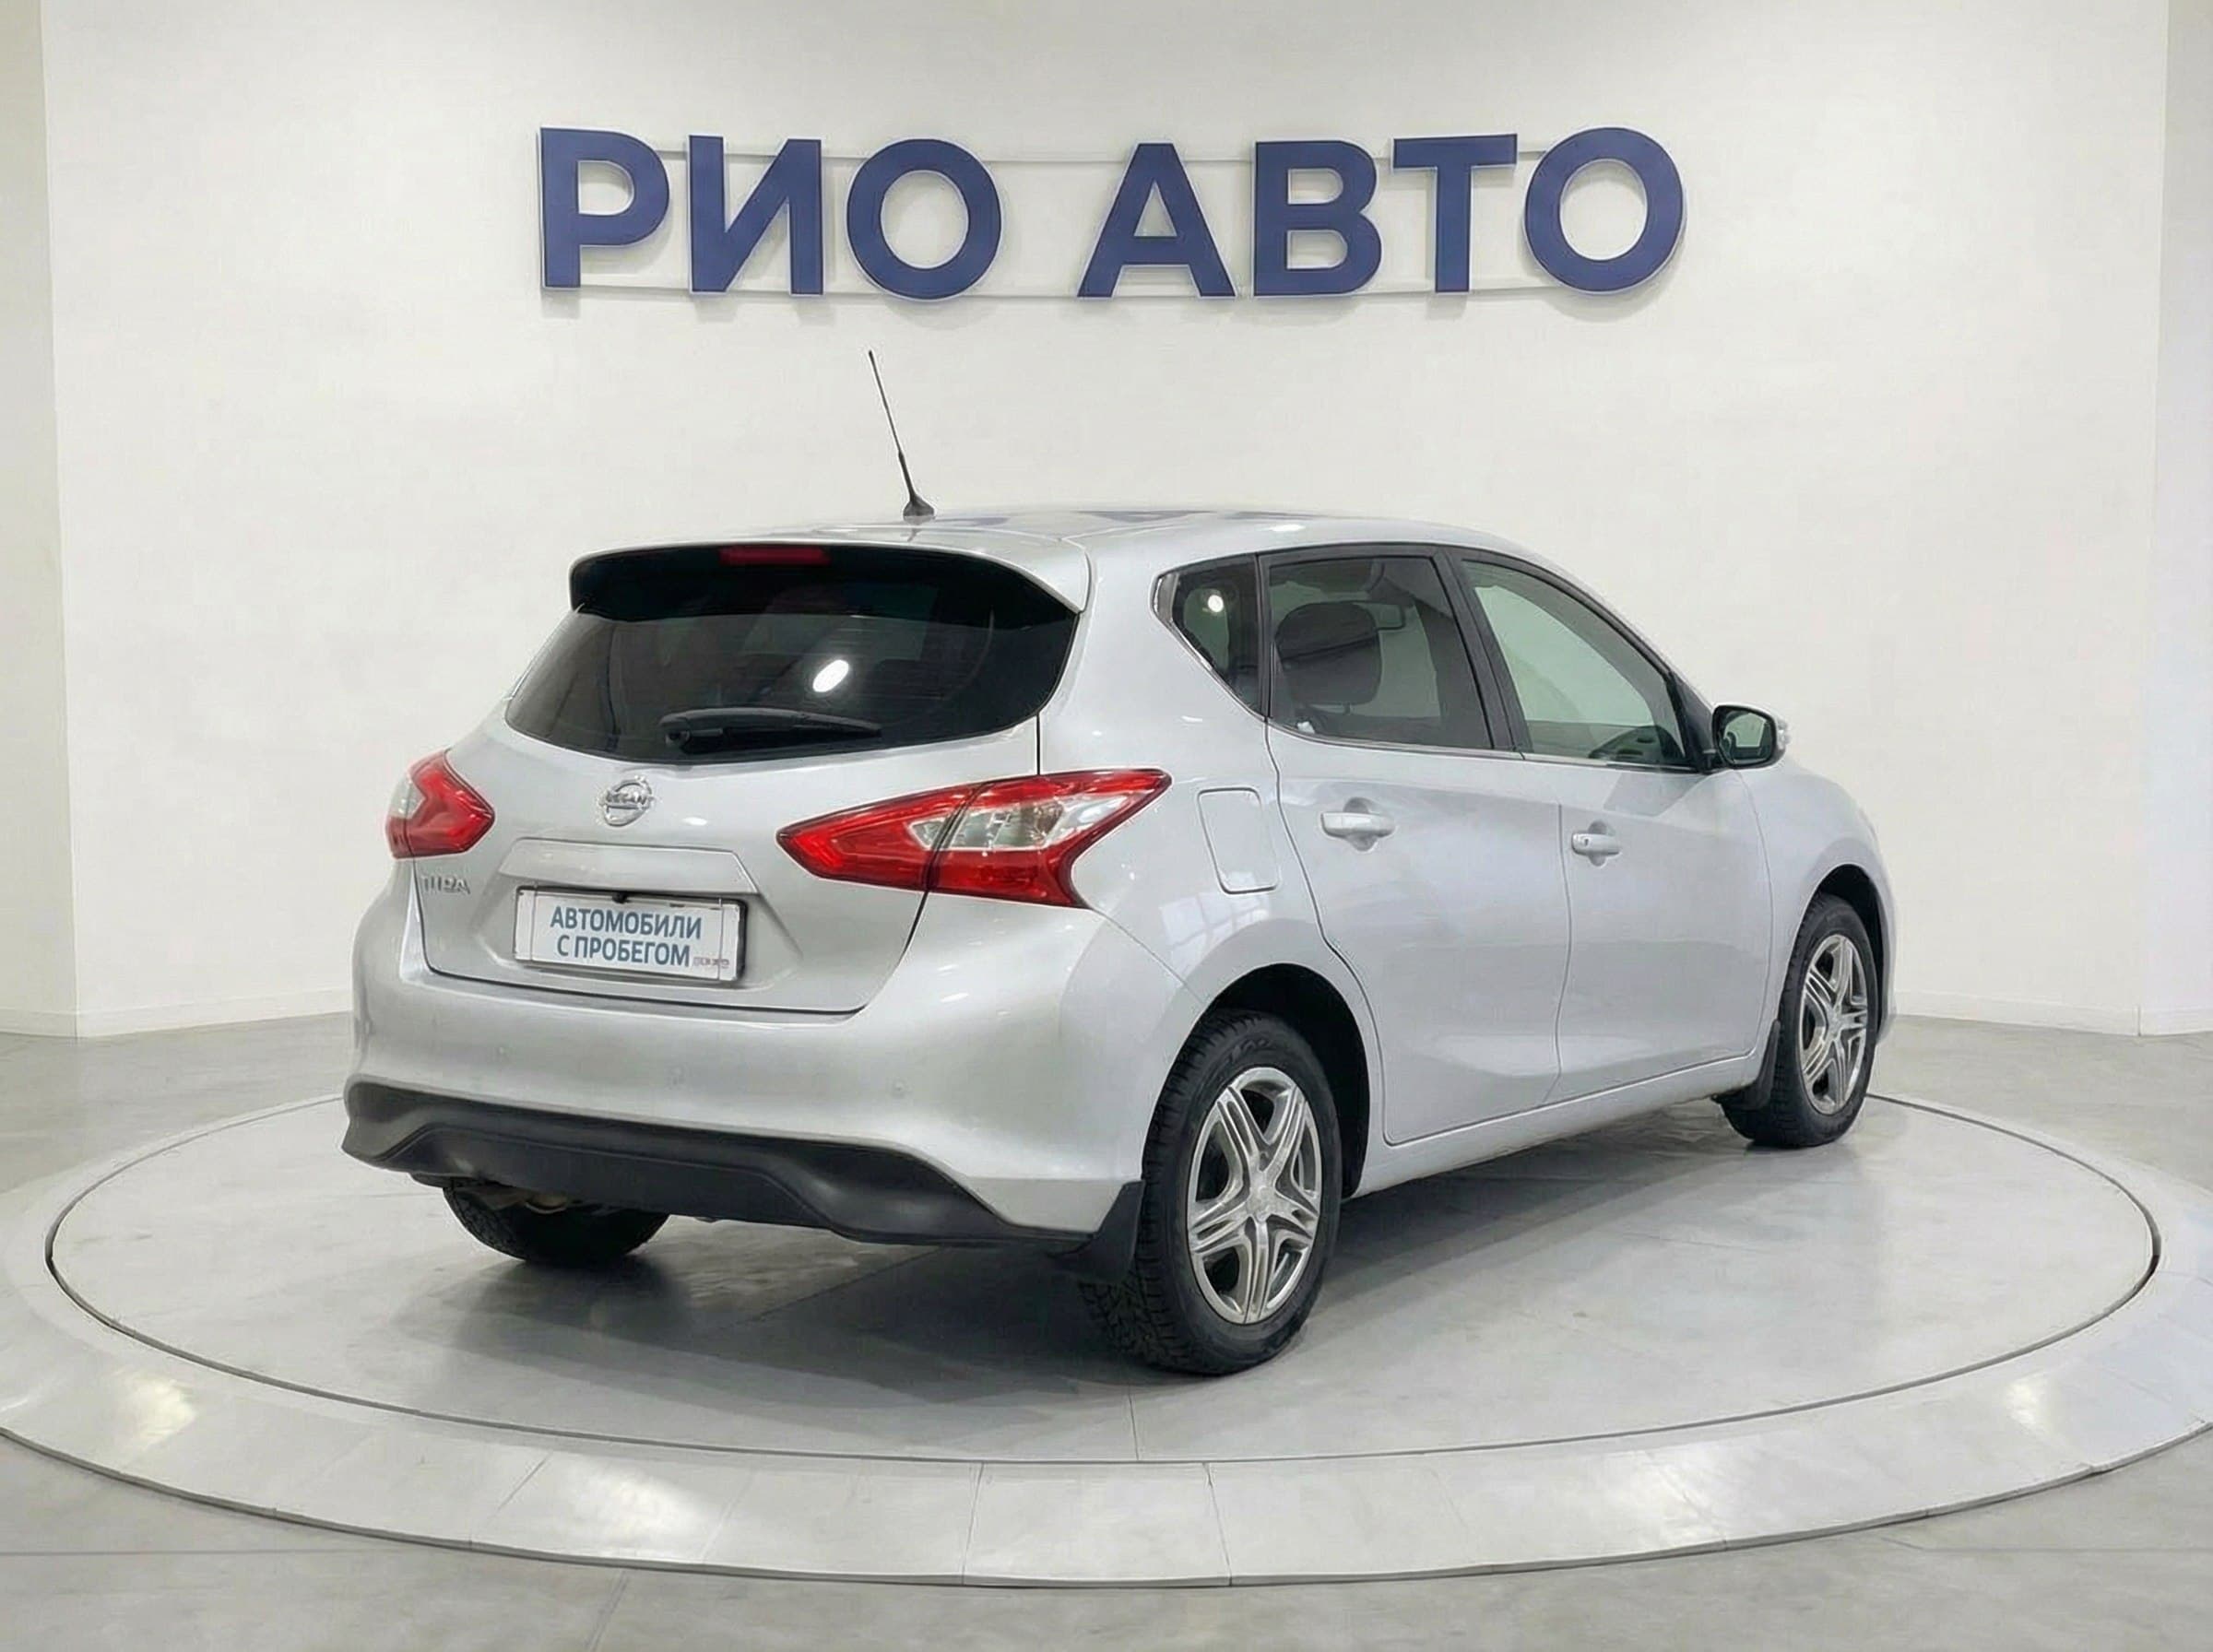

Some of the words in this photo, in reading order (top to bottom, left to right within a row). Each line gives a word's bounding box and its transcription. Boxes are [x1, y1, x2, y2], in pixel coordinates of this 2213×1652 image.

[539, 127, 1003, 300] РИО
[1077, 126, 1686, 297] АВТО
[550, 905, 702, 939] АВТОМОБИЛИ
[557, 934, 570, 957] С
[574, 935, 690, 968] ПРОБЕГОМ
